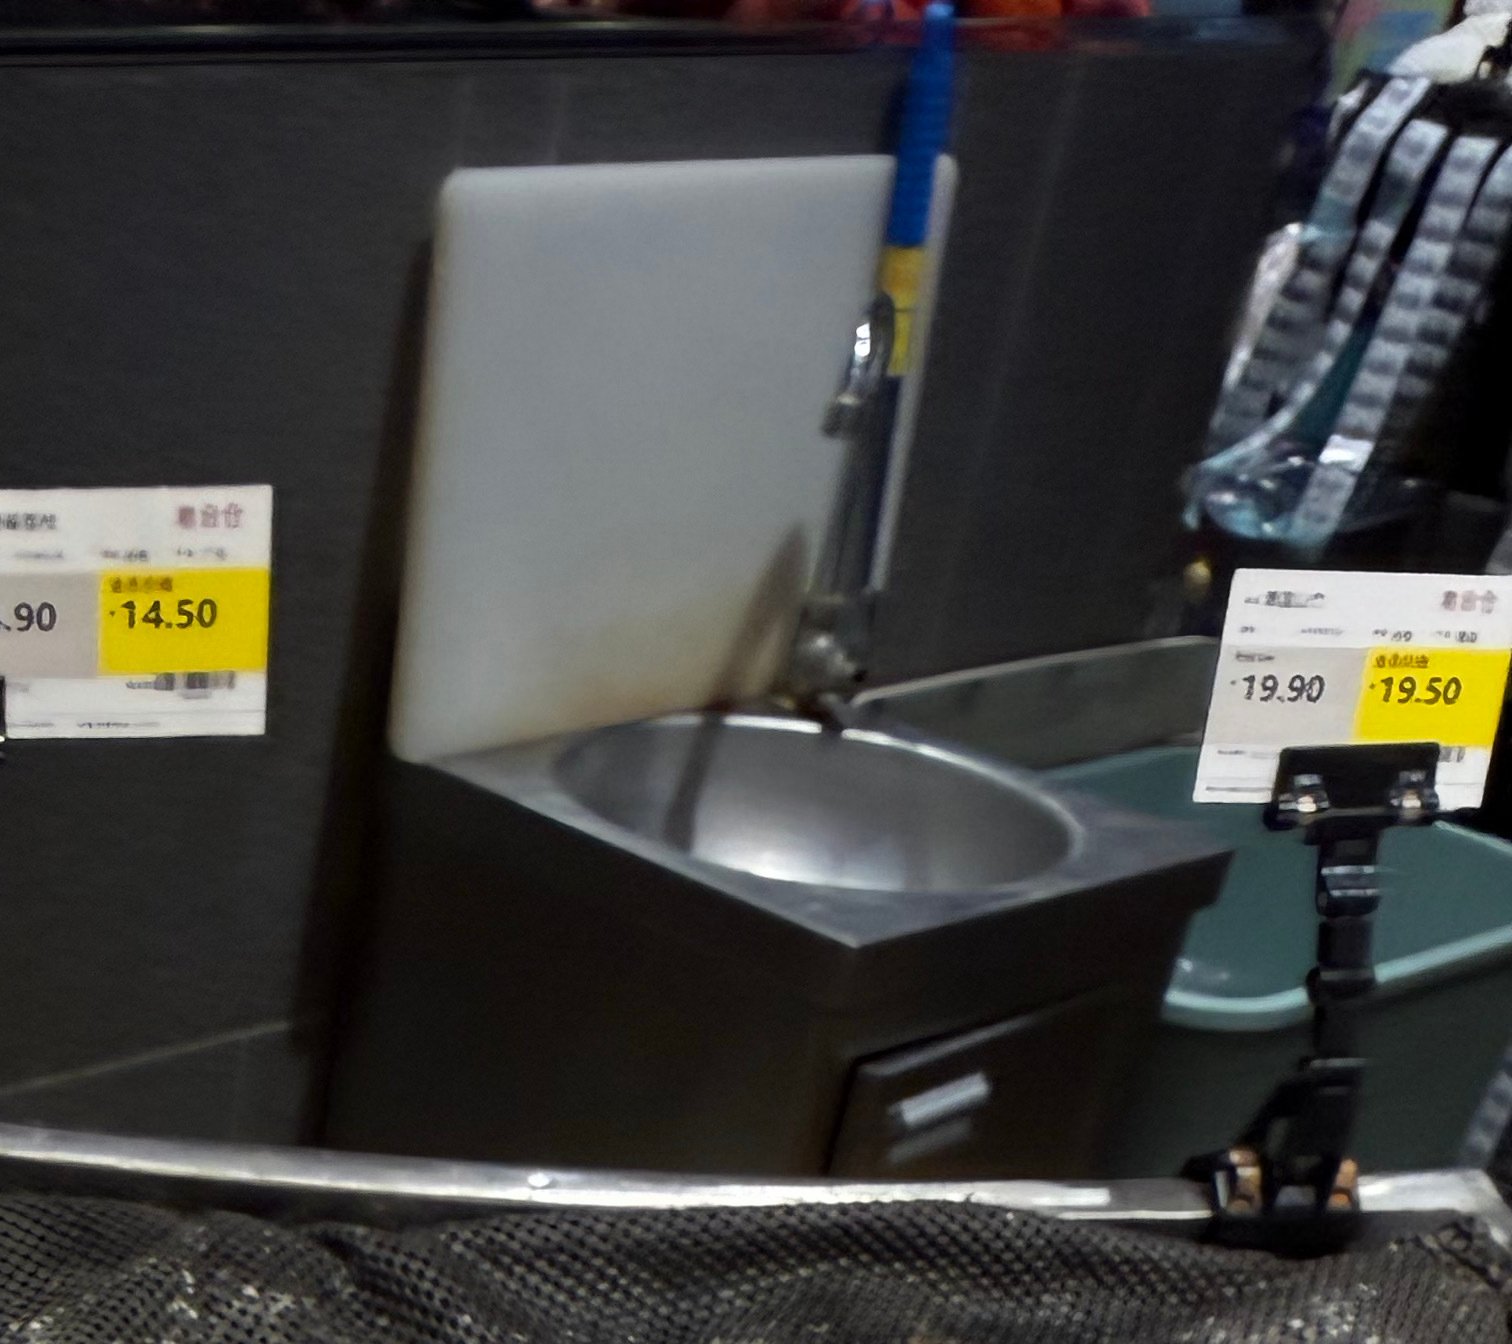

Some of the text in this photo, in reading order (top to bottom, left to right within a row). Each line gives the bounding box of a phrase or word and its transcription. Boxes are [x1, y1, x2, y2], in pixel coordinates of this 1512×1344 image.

[121, 598, 218, 629] 14.50
[1242, 674, 1325, 703] 19.90
[1380, 676, 1462, 705] 19.50
